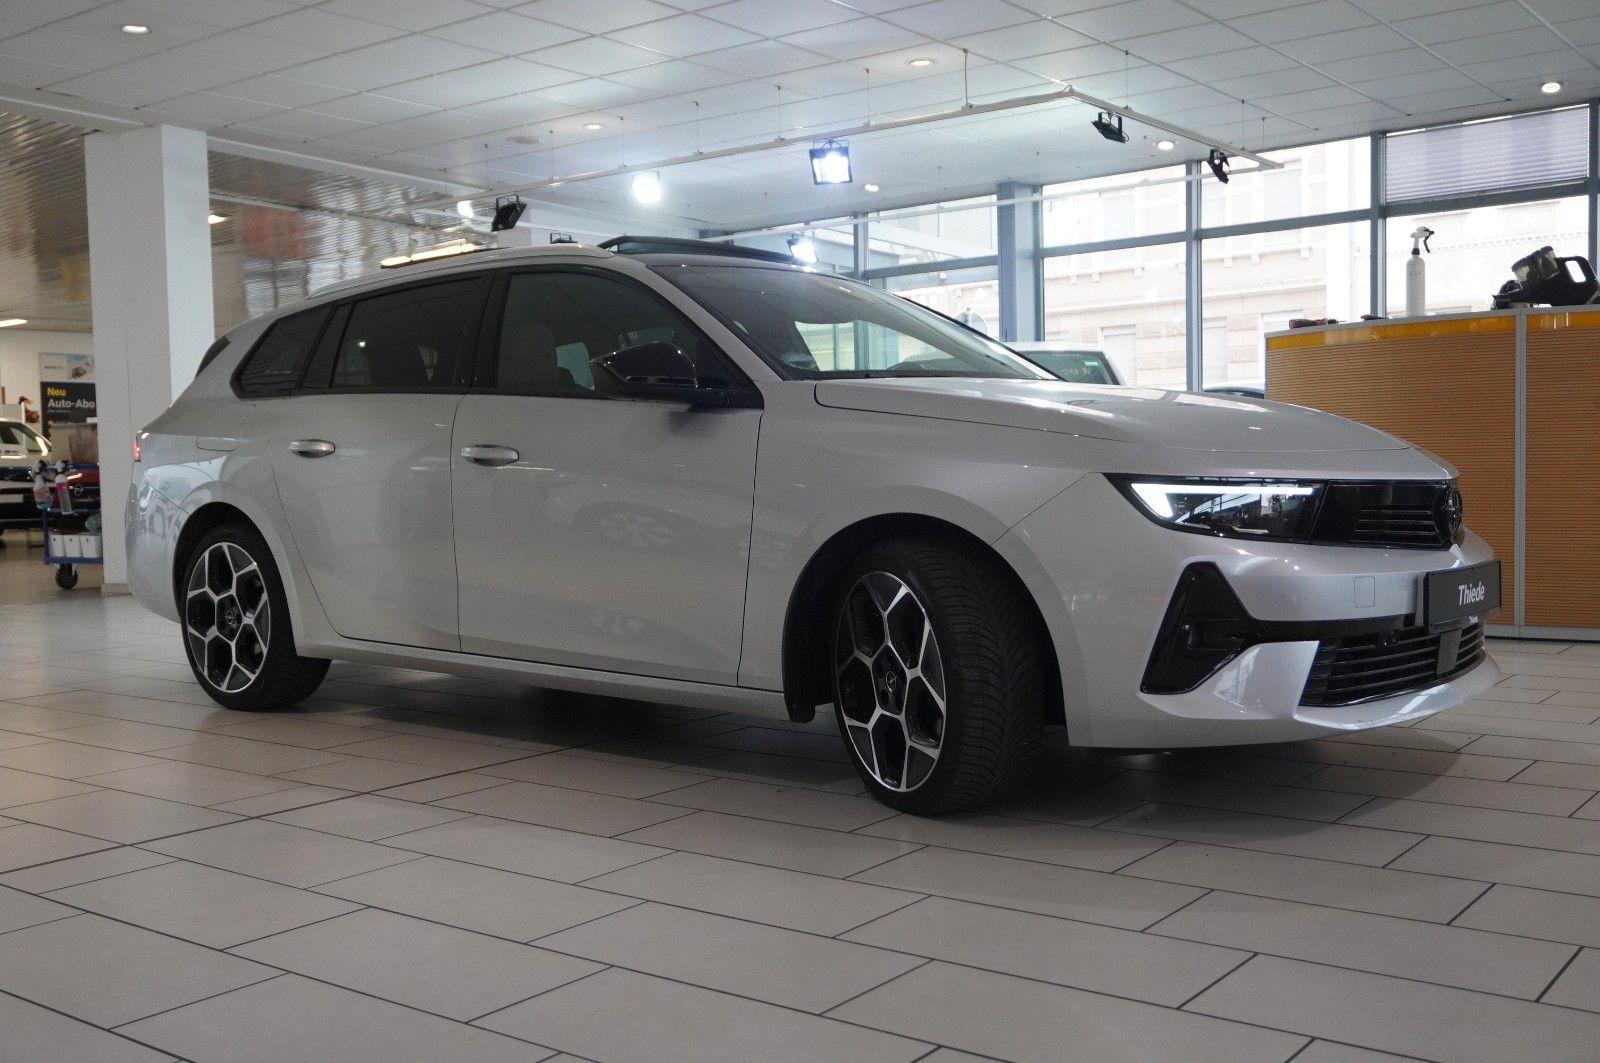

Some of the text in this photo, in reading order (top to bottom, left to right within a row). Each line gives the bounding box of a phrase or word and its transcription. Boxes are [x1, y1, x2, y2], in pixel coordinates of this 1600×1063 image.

[47, 386, 67, 397] Neu
[47, 398, 96, 409] Auto-Abo
[1458, 581, 1485, 605] Thiede
